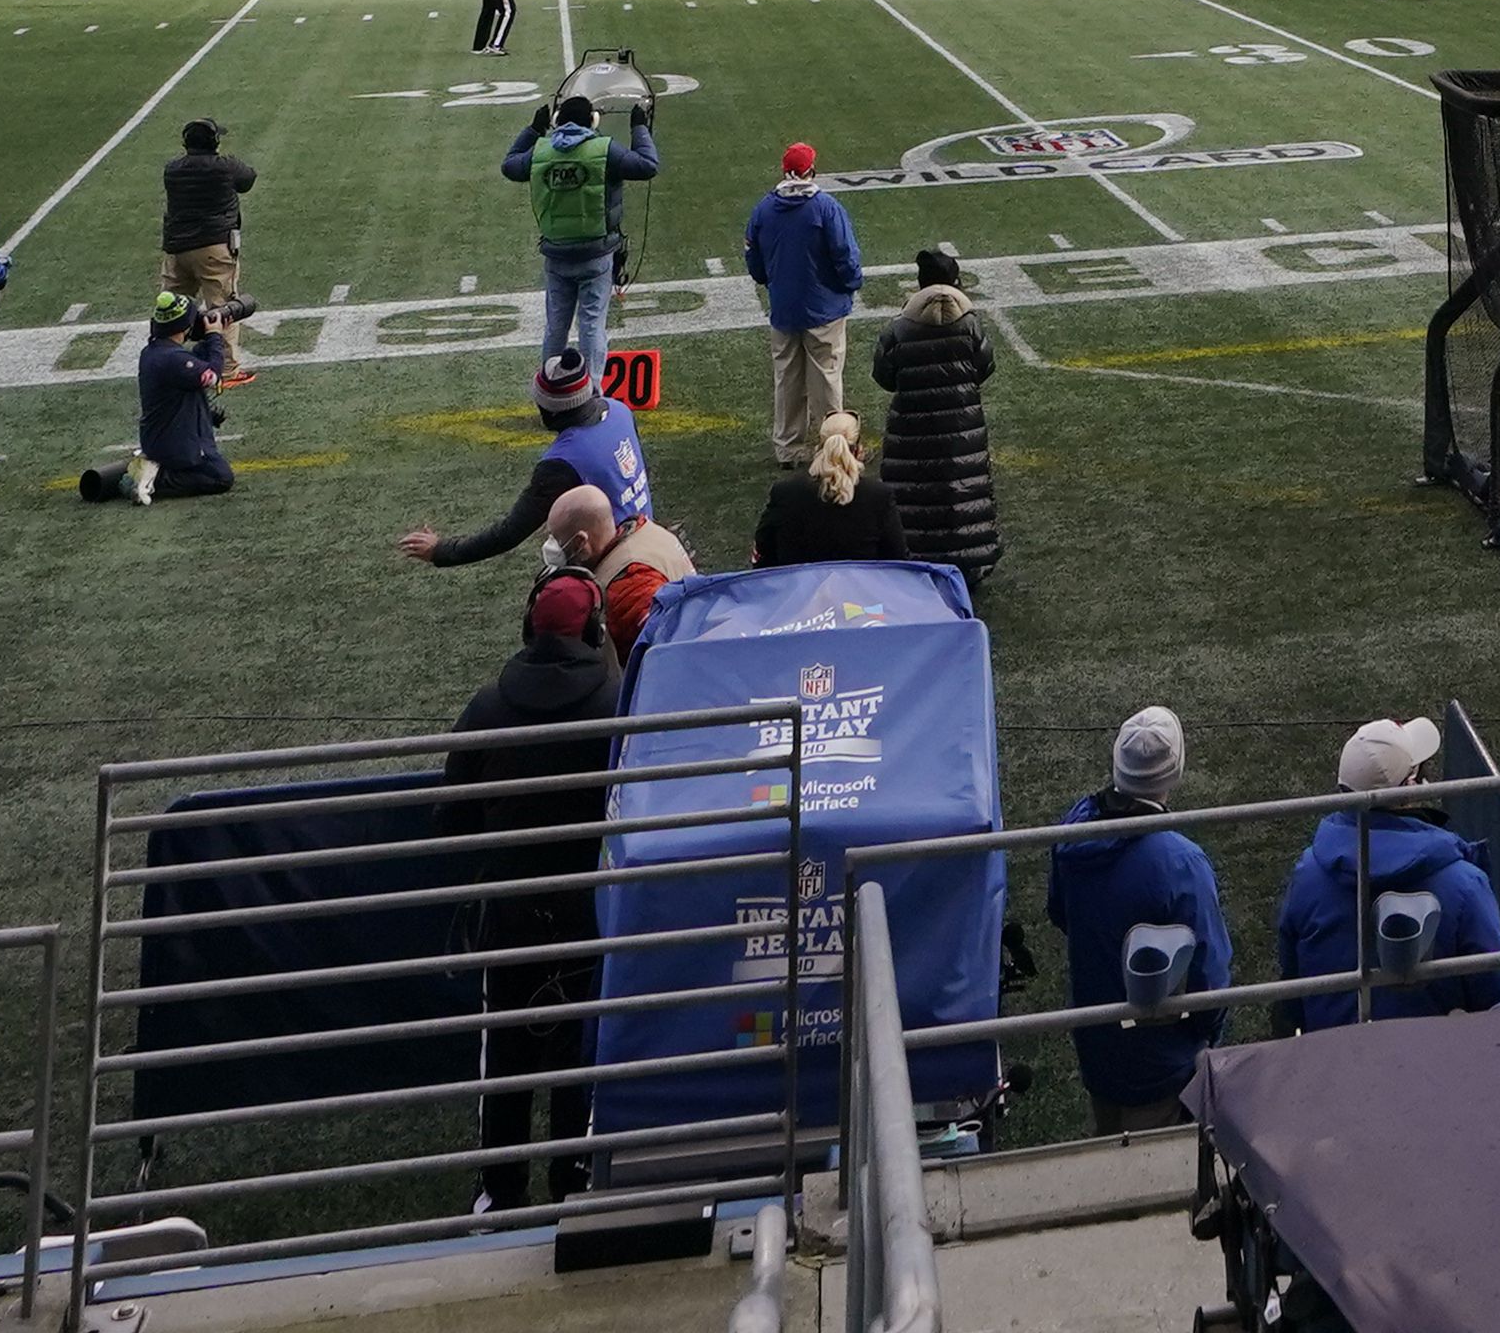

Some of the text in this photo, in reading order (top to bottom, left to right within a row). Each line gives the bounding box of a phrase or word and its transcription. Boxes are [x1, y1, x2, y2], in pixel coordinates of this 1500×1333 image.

[1012, 137, 1111, 153] NFL
[552, 167, 579, 181] FOX
[835, 145, 1329, 187] WILD CARD
[603, 354, 652, 408] 20
[804, 682, 833, 697] NFL
[758, 717, 874, 747] REPLAY
[804, 743, 826, 756] HD
